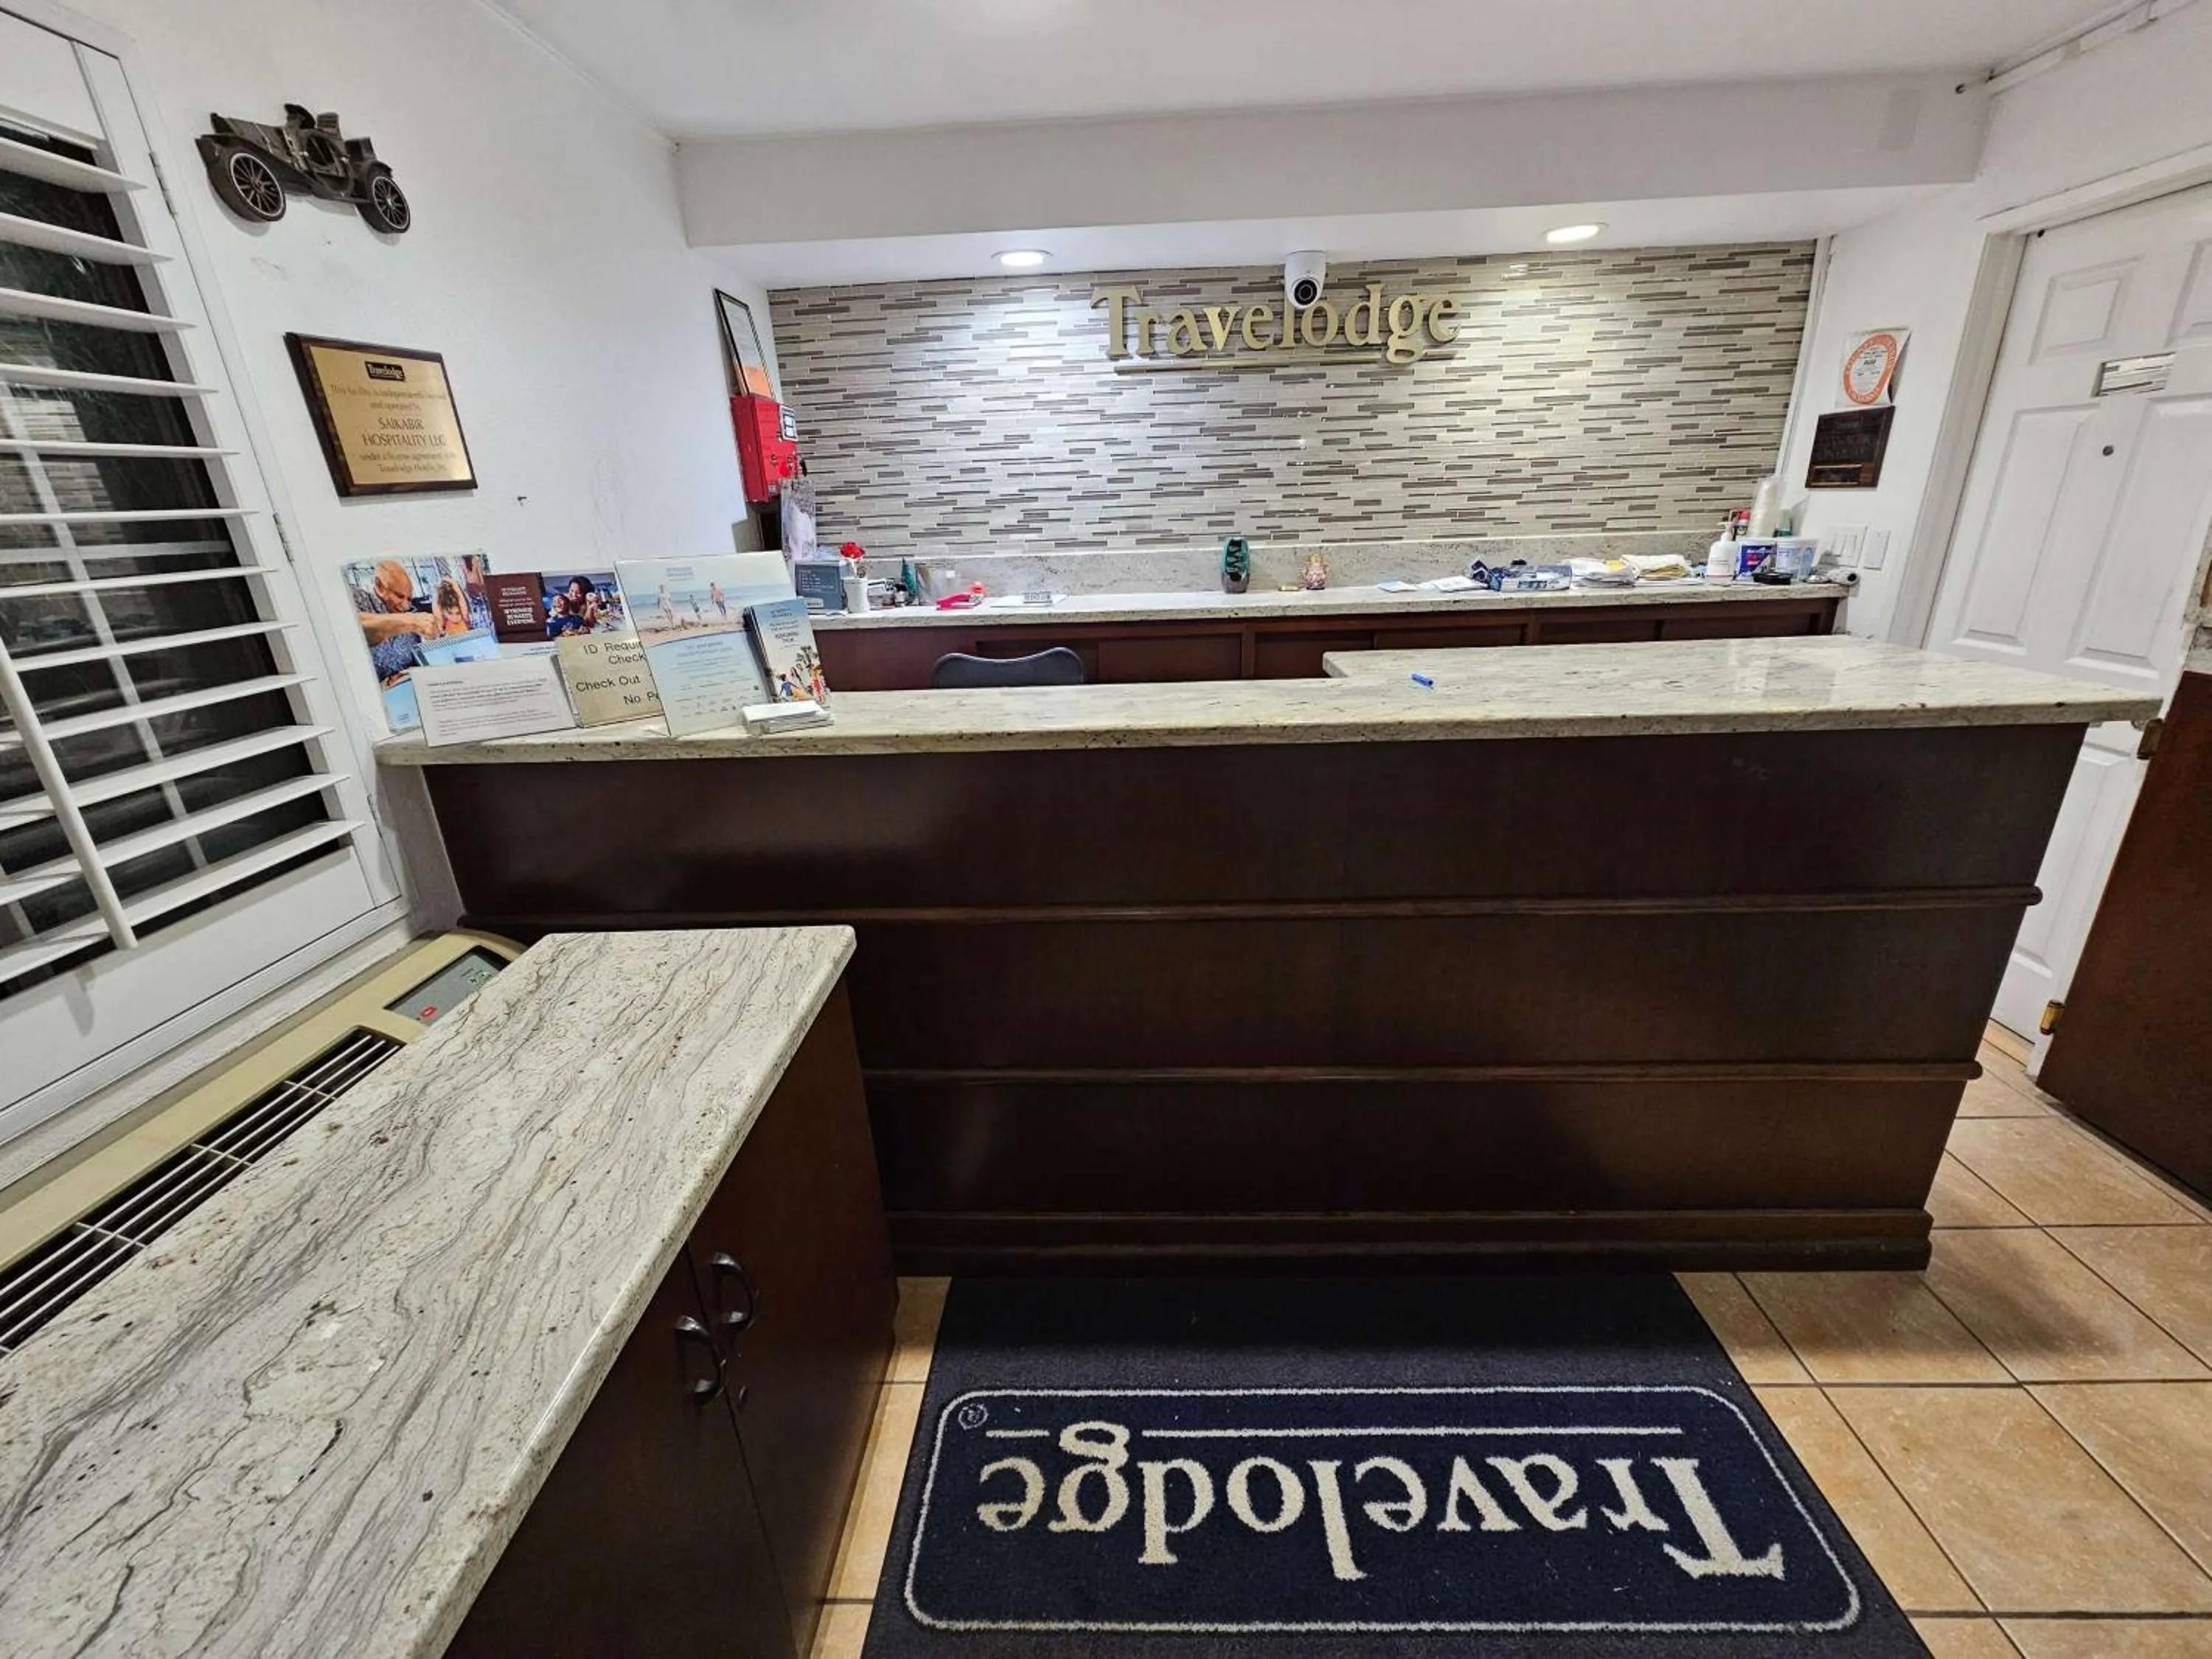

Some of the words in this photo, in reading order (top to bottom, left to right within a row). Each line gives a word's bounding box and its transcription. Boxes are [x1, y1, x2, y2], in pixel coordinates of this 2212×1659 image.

[1091, 284, 1462, 364] Travelodge
[362, 434, 426, 446] HOSPITALITY
[583, 644, 598, 655] ID
[576, 678, 616, 692] Check
[619, 675, 641, 686] Out
[623, 694, 641, 705] No
[978, 1420, 1785, 1582] Travelodge
